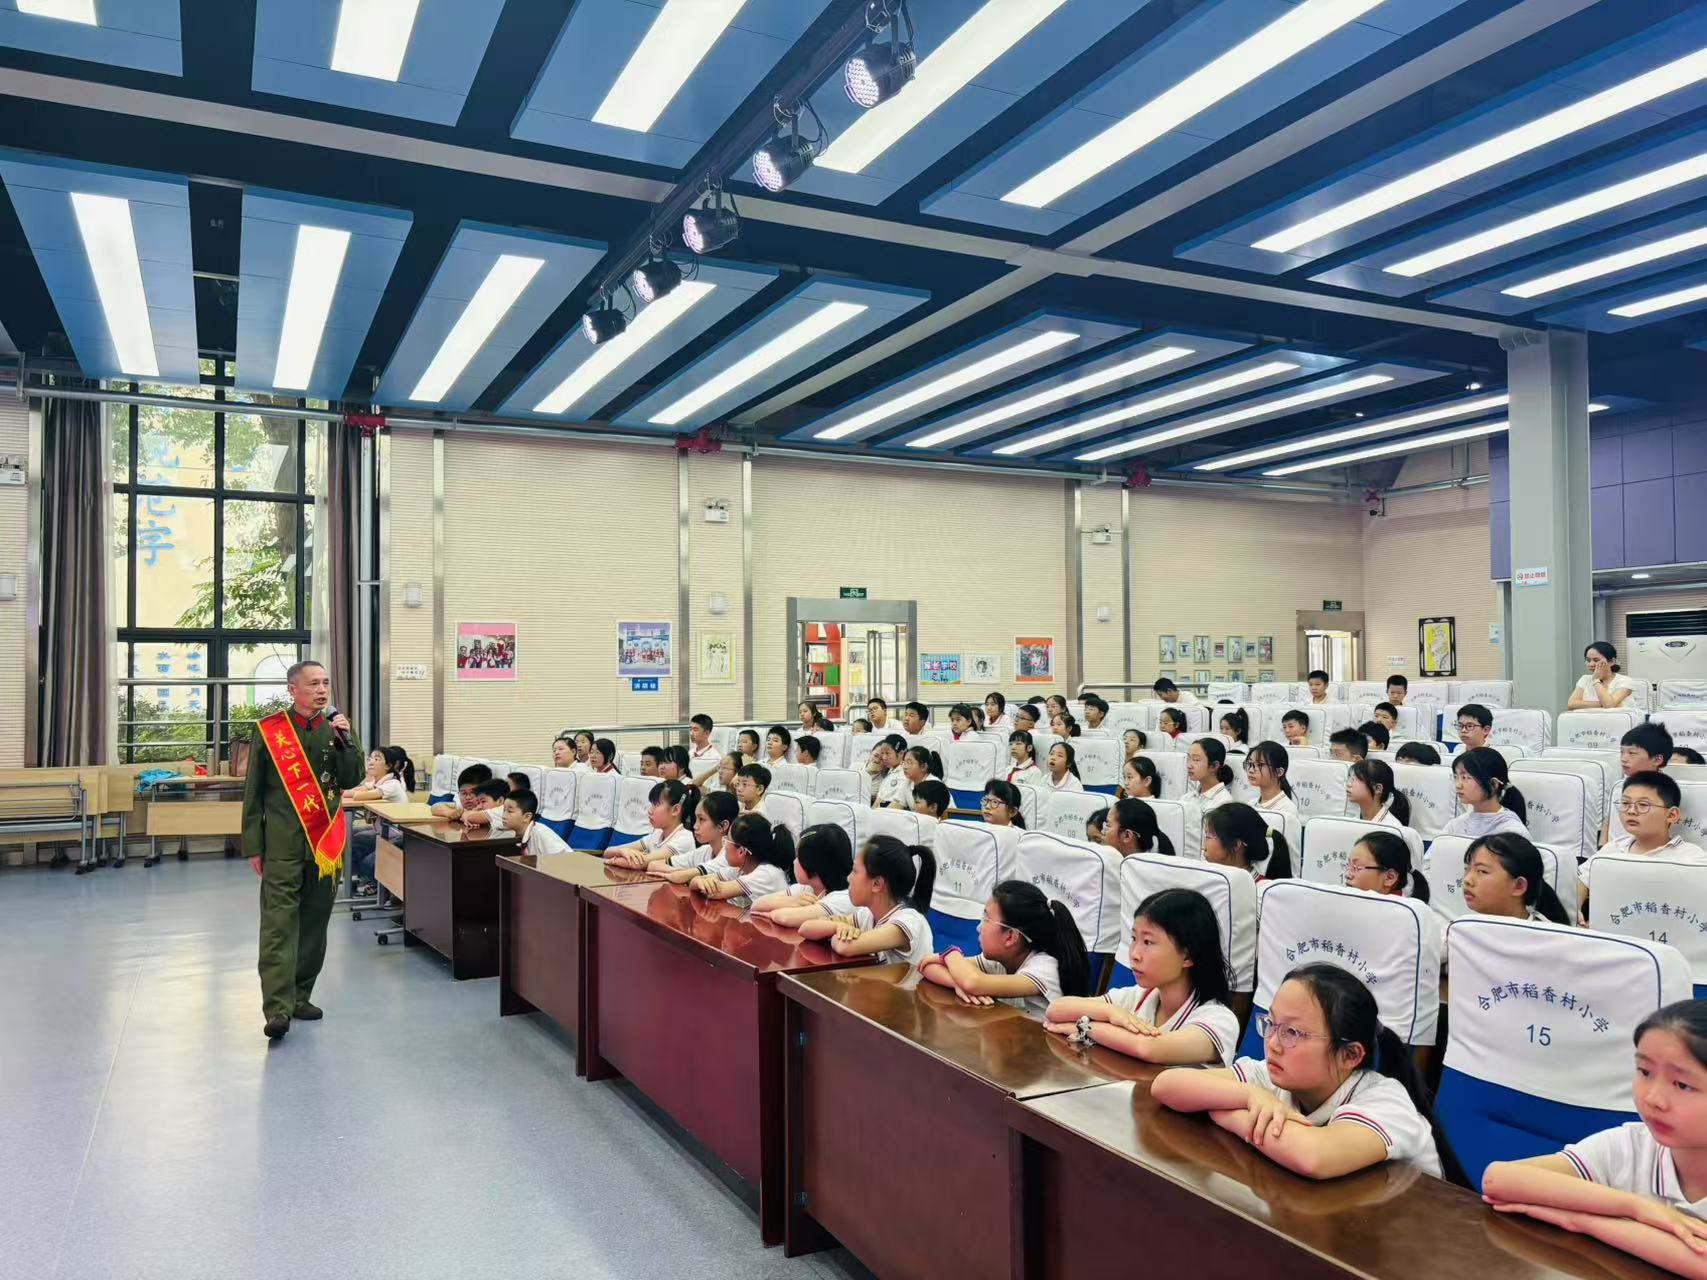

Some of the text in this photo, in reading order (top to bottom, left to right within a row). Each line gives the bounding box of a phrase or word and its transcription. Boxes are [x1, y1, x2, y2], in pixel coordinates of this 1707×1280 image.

[274, 730, 320, 813] 关心下一代
[1300, 797, 1311, 807] 10
[1527, 800, 1560, 824] 香村小学
[953, 881, 962, 892] 11
[1032, 872, 1080, 908] 肥市稻香村小学
[1609, 900, 1707, 933] 合肥市稻香村小学
[1648, 930, 1669, 944] 14
[1286, 937, 1378, 985] 合肥市稻香村小学
[1478, 981, 1610, 1033] 合肥市稻香村小学
[1525, 1023, 1551, 1047] 15
